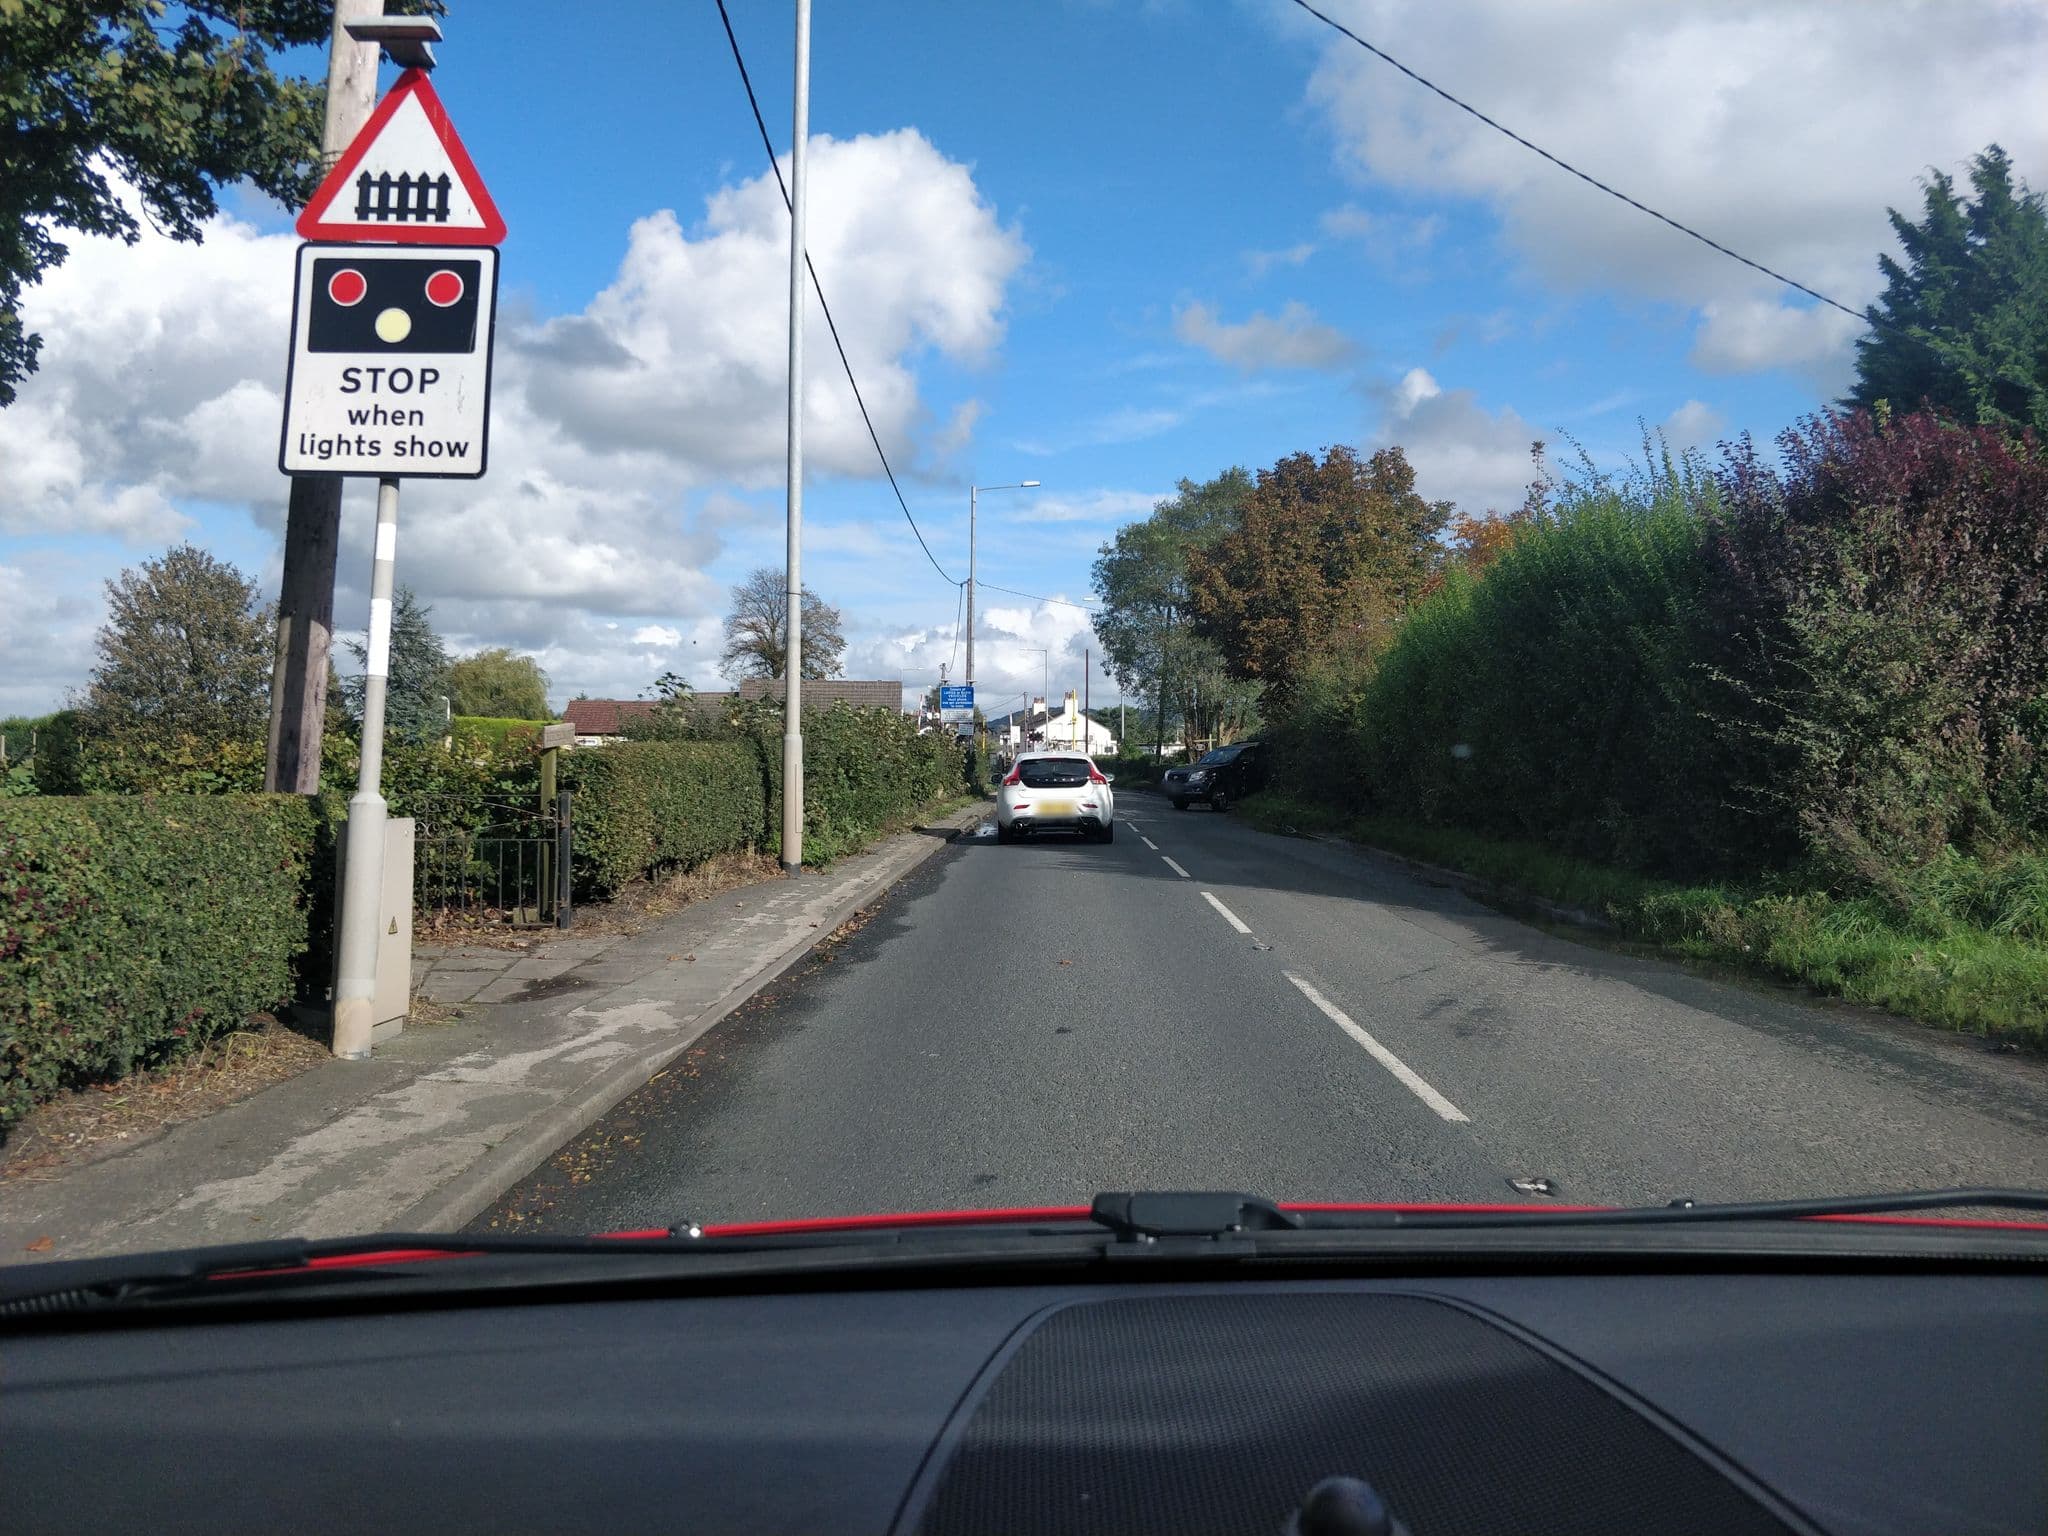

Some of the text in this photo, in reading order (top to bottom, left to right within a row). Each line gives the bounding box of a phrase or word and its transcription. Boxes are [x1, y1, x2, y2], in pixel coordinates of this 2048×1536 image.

[340, 367, 440, 394] STOP
[347, 403, 424, 427] when
[299, 433, 469, 460] lights show
